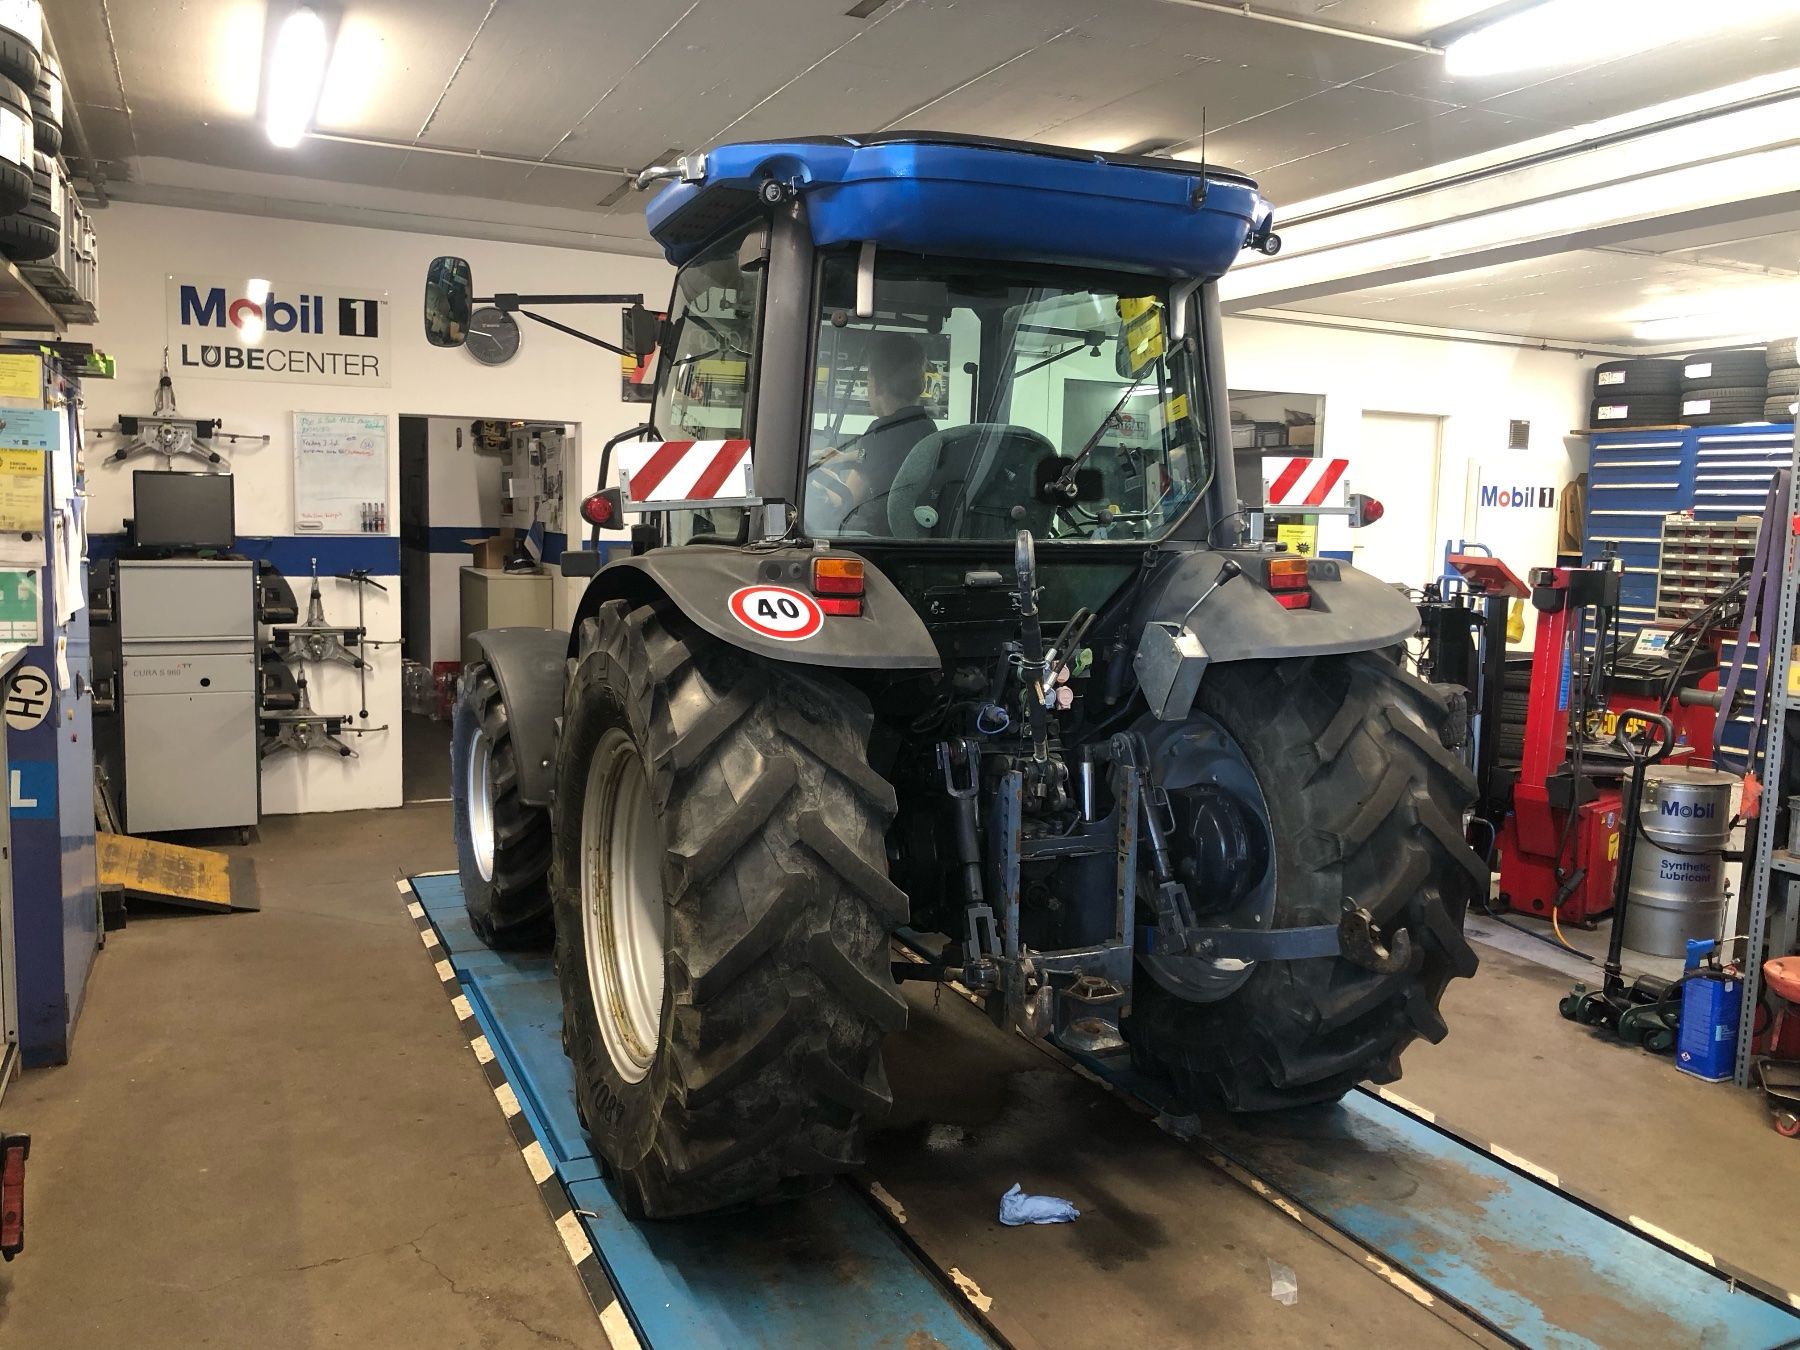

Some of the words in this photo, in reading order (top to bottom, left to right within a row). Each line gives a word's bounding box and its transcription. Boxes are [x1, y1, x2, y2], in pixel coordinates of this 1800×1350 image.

[180, 285, 323, 335] Mobil
[1481, 486, 1535, 507] Mobil
[758, 598, 799, 619] 40
[6, 675, 48, 719] CH
[11, 770, 38, 808] L
[1661, 800, 1715, 819] Mobil
[1660, 870, 1712, 883] Lubricant
[1661, 860, 1712, 872] Synthetic
